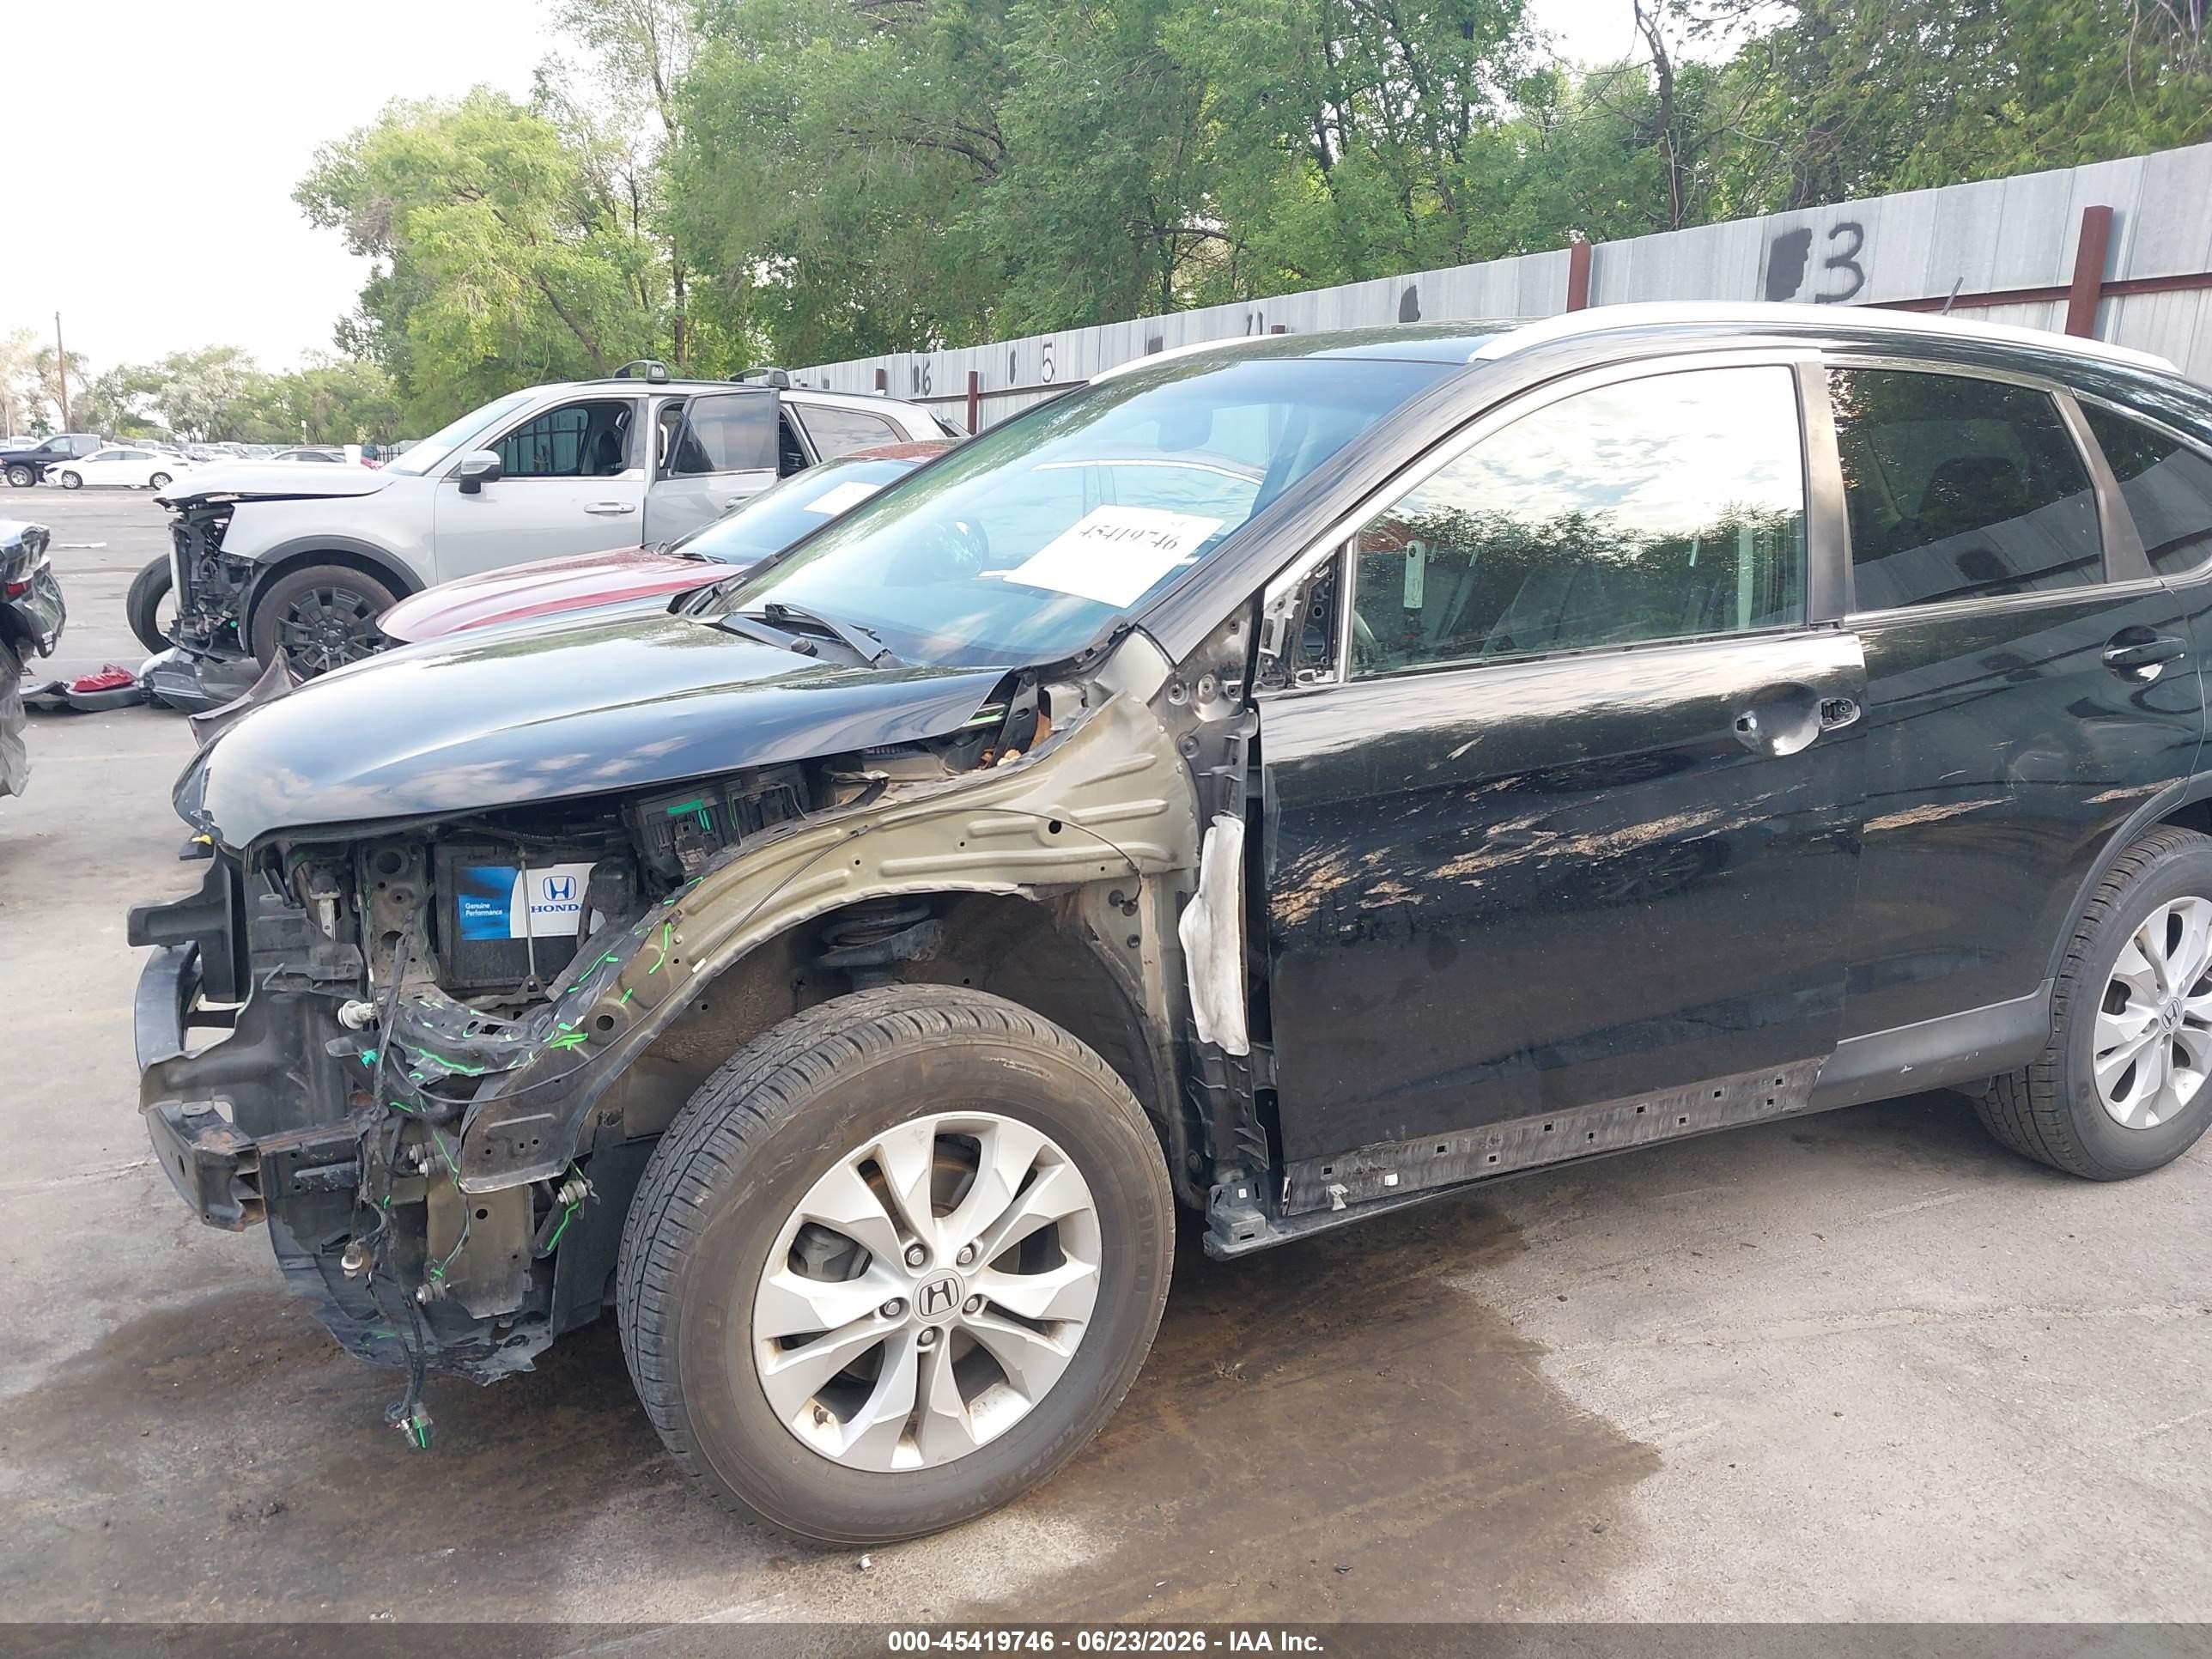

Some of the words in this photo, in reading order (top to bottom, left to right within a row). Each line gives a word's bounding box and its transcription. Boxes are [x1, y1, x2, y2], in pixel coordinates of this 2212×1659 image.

[1814, 222, 1866, 304] 3
[1042, 343, 1055, 384] 5
[465, 902, 490, 910] Genuine
[530, 903, 583, 914] HOND
